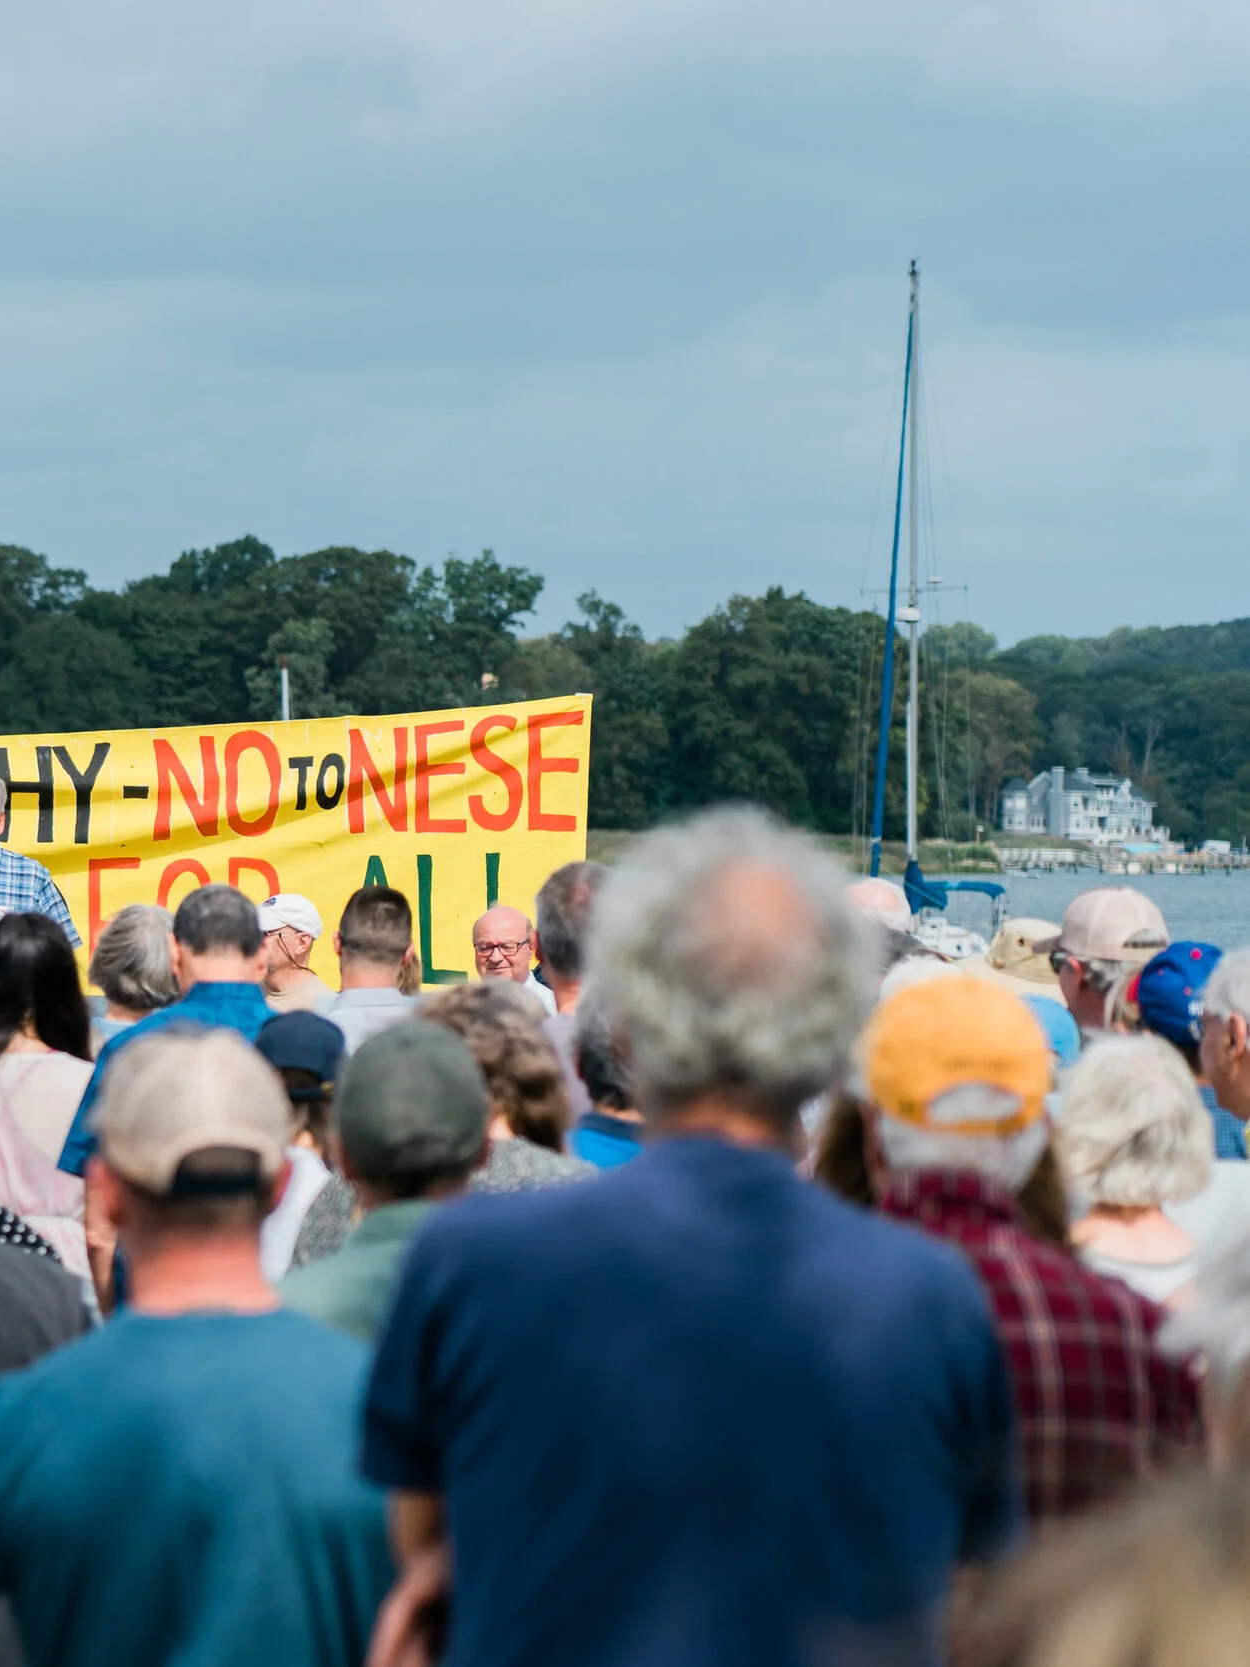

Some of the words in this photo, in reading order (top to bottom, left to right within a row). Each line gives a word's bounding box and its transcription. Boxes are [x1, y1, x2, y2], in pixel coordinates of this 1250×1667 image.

[152, 730, 282, 841] NO
[288, 752, 345, 811] TO
[347, 710, 584, 834] NESE
